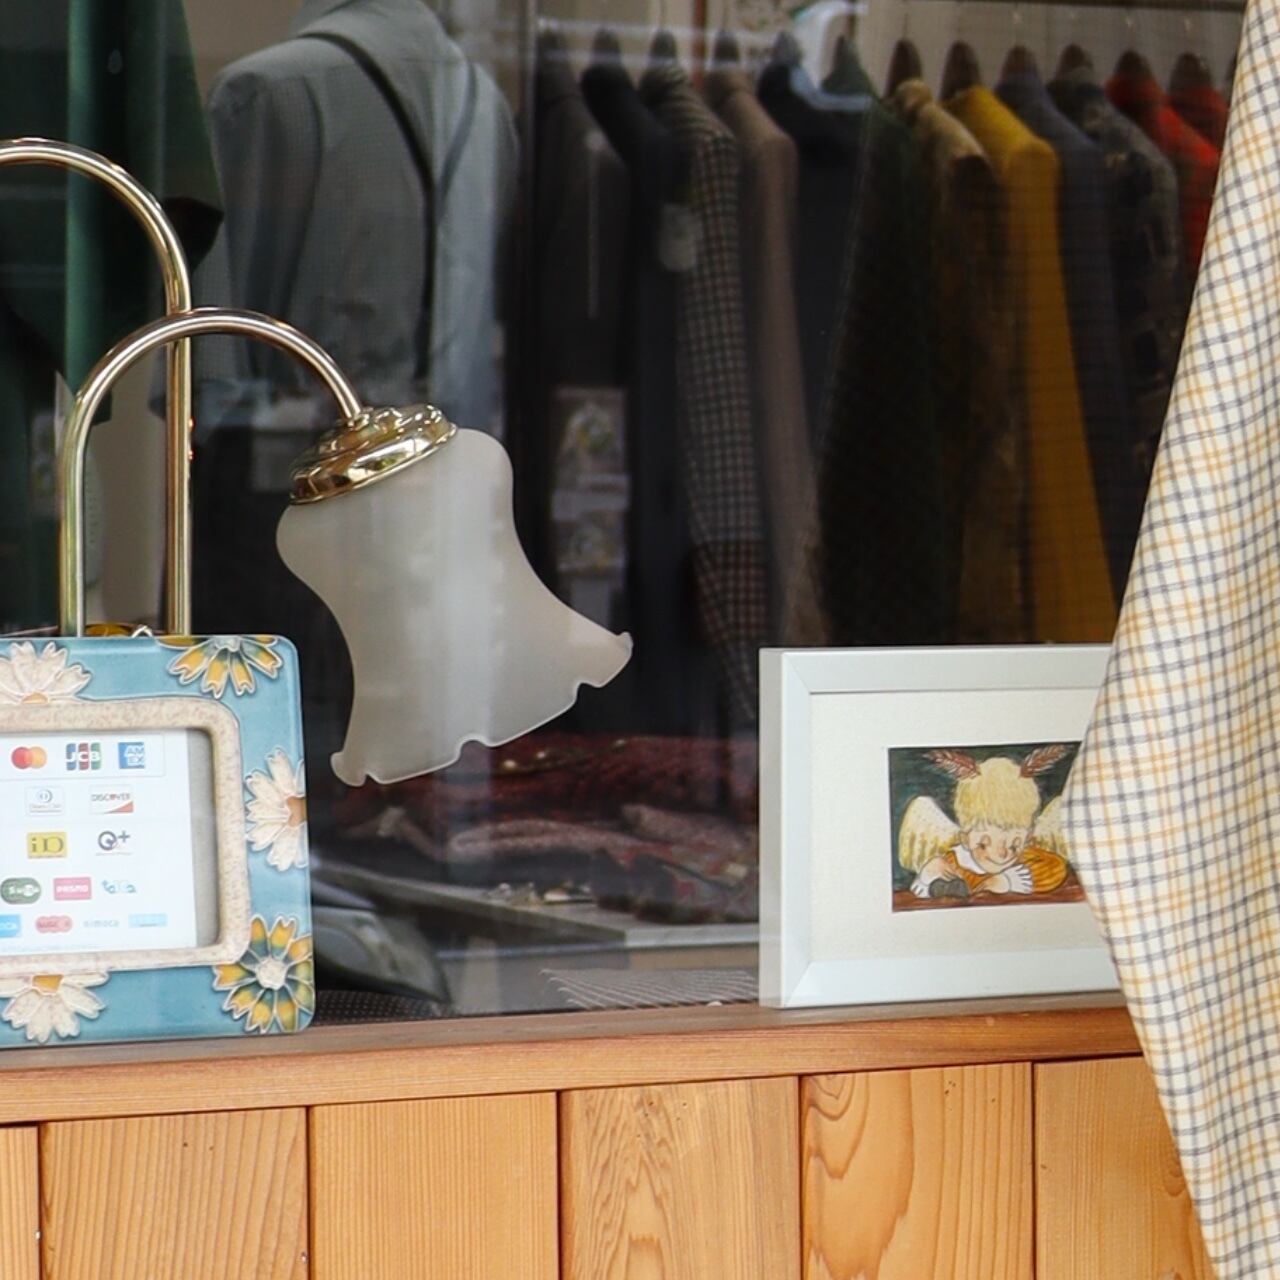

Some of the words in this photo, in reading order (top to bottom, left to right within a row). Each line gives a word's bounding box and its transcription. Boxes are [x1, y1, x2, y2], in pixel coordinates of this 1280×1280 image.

[67, 748, 102, 766] JCB
[124, 745, 145, 756] AM
[127, 756, 145, 767] EX
[31, 836, 64, 853] iD
